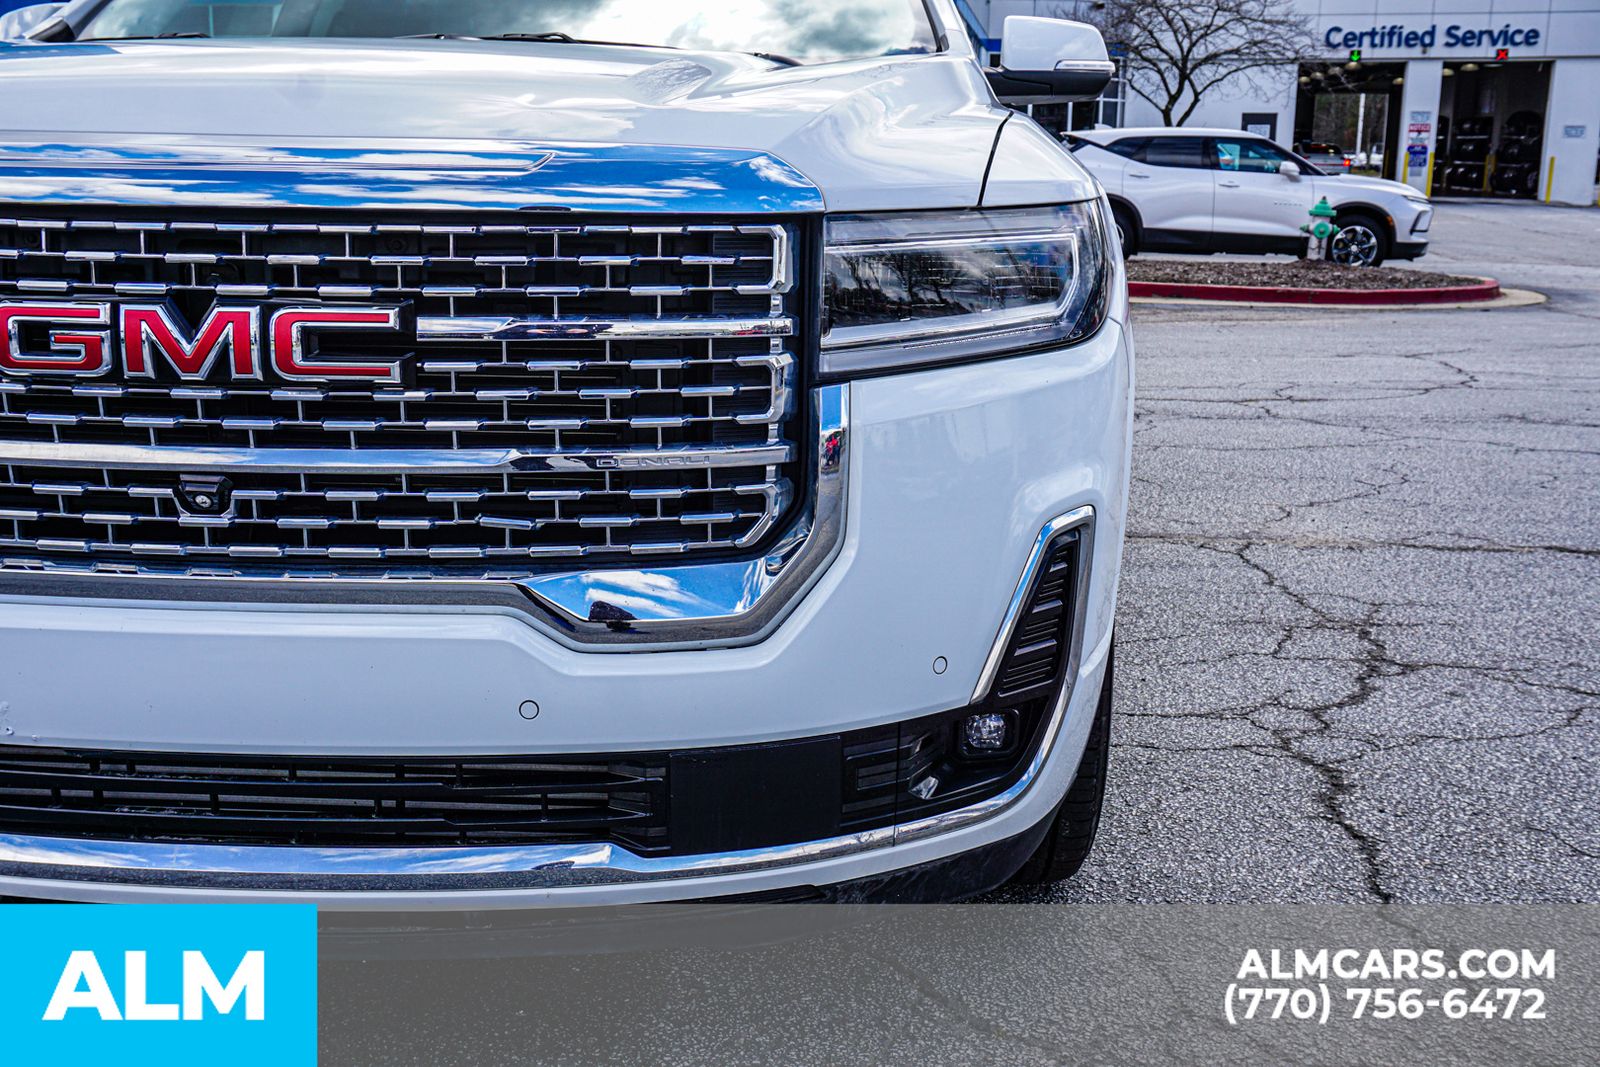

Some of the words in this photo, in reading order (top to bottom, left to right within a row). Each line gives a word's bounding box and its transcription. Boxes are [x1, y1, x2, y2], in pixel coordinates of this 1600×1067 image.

[1325, 25, 1436, 49] Certified
[1444, 24, 1540, 47] Service
[0, 300, 402, 382] GMC
[596, 455, 710, 468] DENALI
